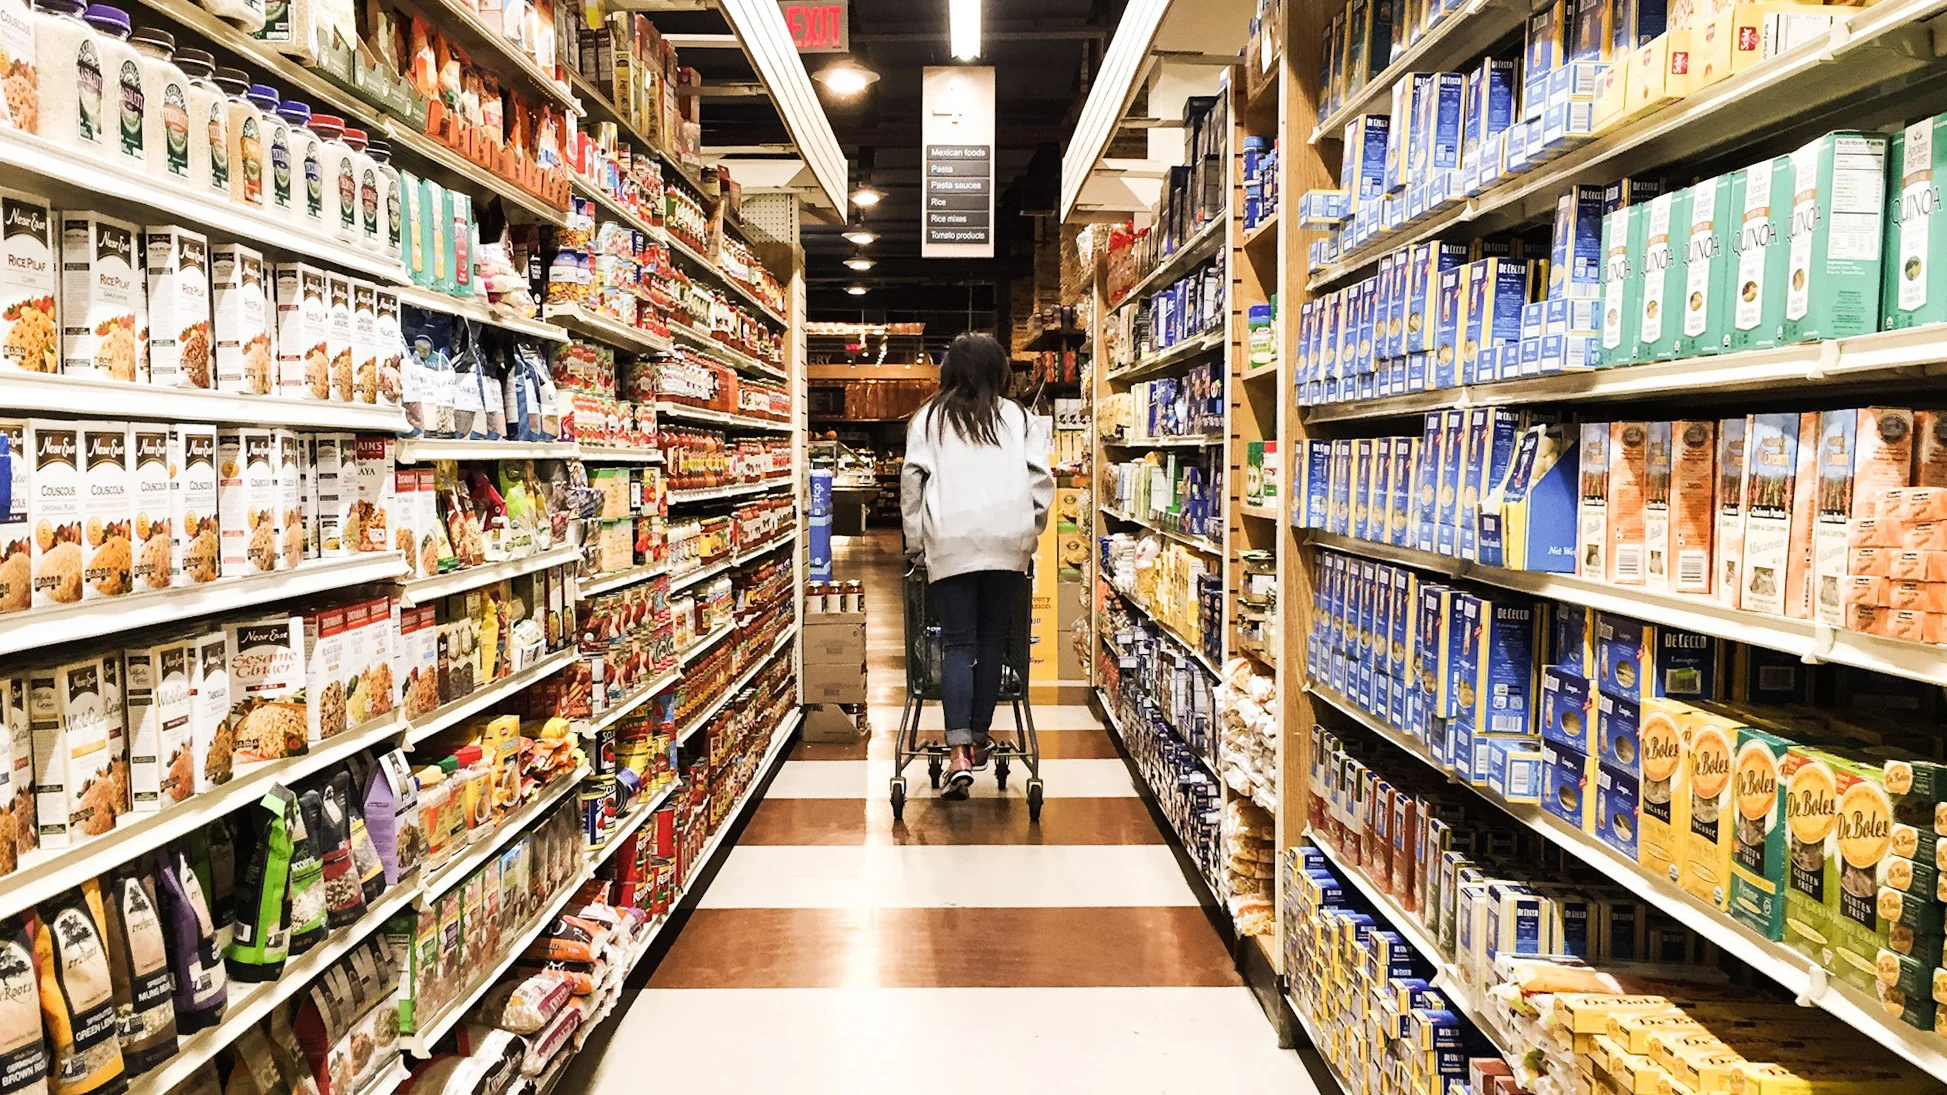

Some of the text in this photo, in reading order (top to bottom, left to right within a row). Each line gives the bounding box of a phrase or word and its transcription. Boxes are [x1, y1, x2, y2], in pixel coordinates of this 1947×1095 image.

[787, 7, 841, 48] EXIT
[931, 149, 985, 157] Mexican foods
[931, 165, 953, 174] Pasta
[931, 181, 981, 190] Pasta sauces
[931, 198, 946, 207] Rice
[1892, 187, 1943, 229] QUINOA
[6, 208, 46, 232] Near East
[931, 215, 967, 223] Rice mixes
[98, 232, 130, 254] Near East
[931, 231, 985, 240] Tomato products
[1732, 223, 1778, 257] QUINOA
[8, 253, 46, 272] RICE PILAF
[1499, 263, 1525, 274] DE CECCO
[100, 273, 130, 290] RICE PILAF
[38, 432, 76, 457] Near East
[87, 432, 125, 458] Near East
[138, 434, 166, 457] Near East
[187, 434, 213, 458] Near East
[41, 485, 75, 497] COUSCOUS
[91, 484, 124, 496] COUSCOUS
[141, 481, 167, 492] COUSCOUS
[1548, 546, 1562, 556] Net
[1498, 608, 1529, 620] DE CECCO
[240, 629, 288, 645] Near East
[1665, 632, 1707, 649] DE CECCO
[232, 651, 298, 668] Sesame
[235, 661, 295, 680] Ginger
[1641, 735, 1679, 760] DeBoles
[1691, 751, 1729, 777] DeBoles
[1736, 769, 1776, 796] DeBoles
[1644, 804, 1669, 820] ORGANIC
[1787, 789, 1835, 818] DeBoles
[1692, 820, 1717, 839] ORGANIC
[1837, 810, 1888, 840] DeBoles
[1742, 855, 1755, 867] FREE
[1794, 867, 1819, 887] GLUTEN
[1797, 879, 1814, 895] FREE
[1843, 893, 1871, 914] GLUTEN
[1517, 908, 1538, 917] DE CECCO
[1848, 905, 1865, 922] FREE
[138, 986, 161, 1002] MUNG
[76, 1022, 101, 1042] GREEN
[2, 1065, 34, 1087] BROWN
